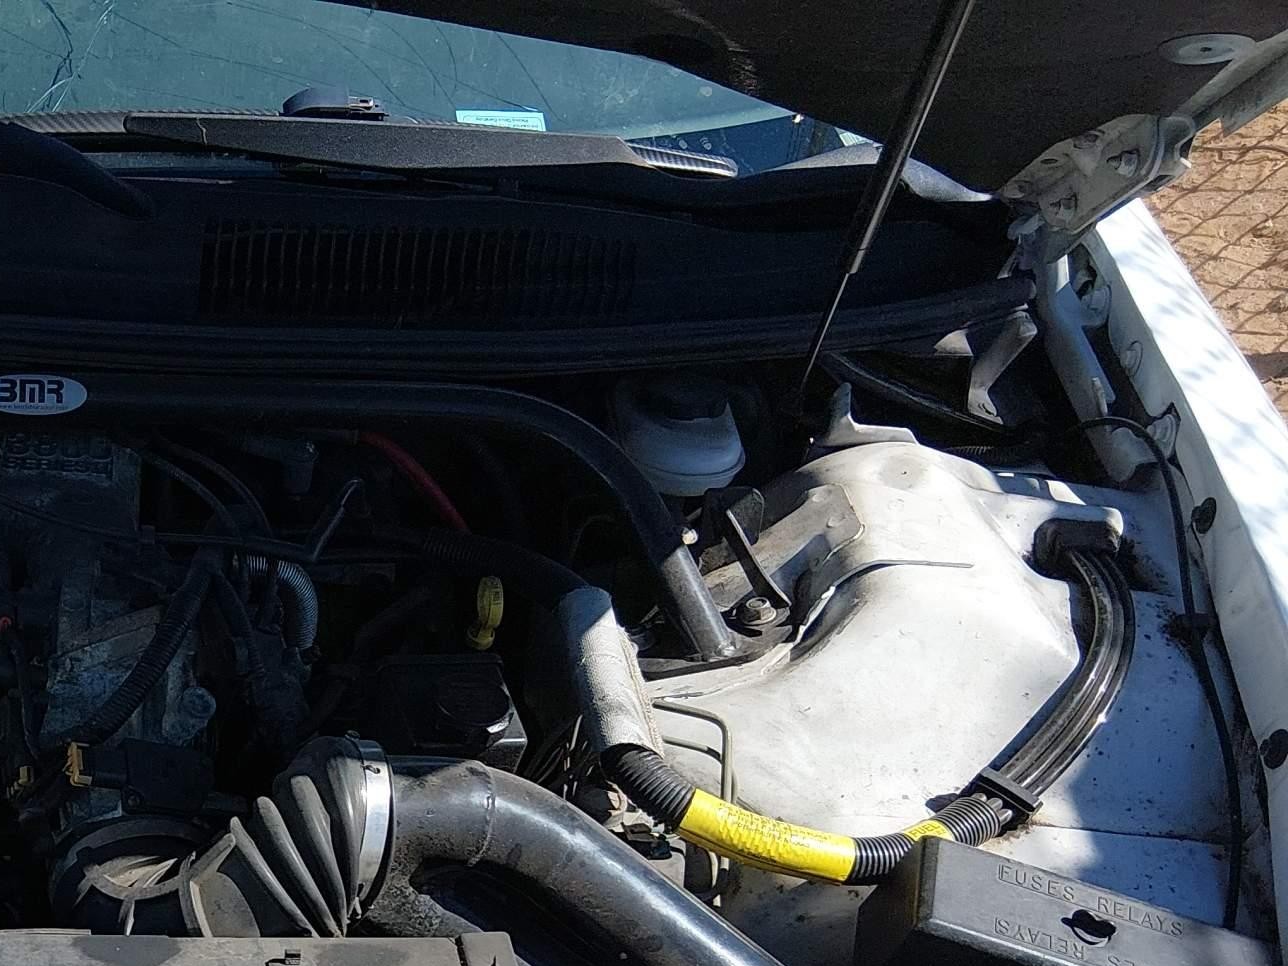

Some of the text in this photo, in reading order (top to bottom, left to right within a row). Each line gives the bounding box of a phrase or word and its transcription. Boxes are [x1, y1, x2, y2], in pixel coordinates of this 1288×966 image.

[0, 379, 65, 404] BMR
[908, 823, 941, 837] FUEL
[999, 864, 1183, 936] FUSES RELAYS
[997, 918, 1085, 960] RELAYS
